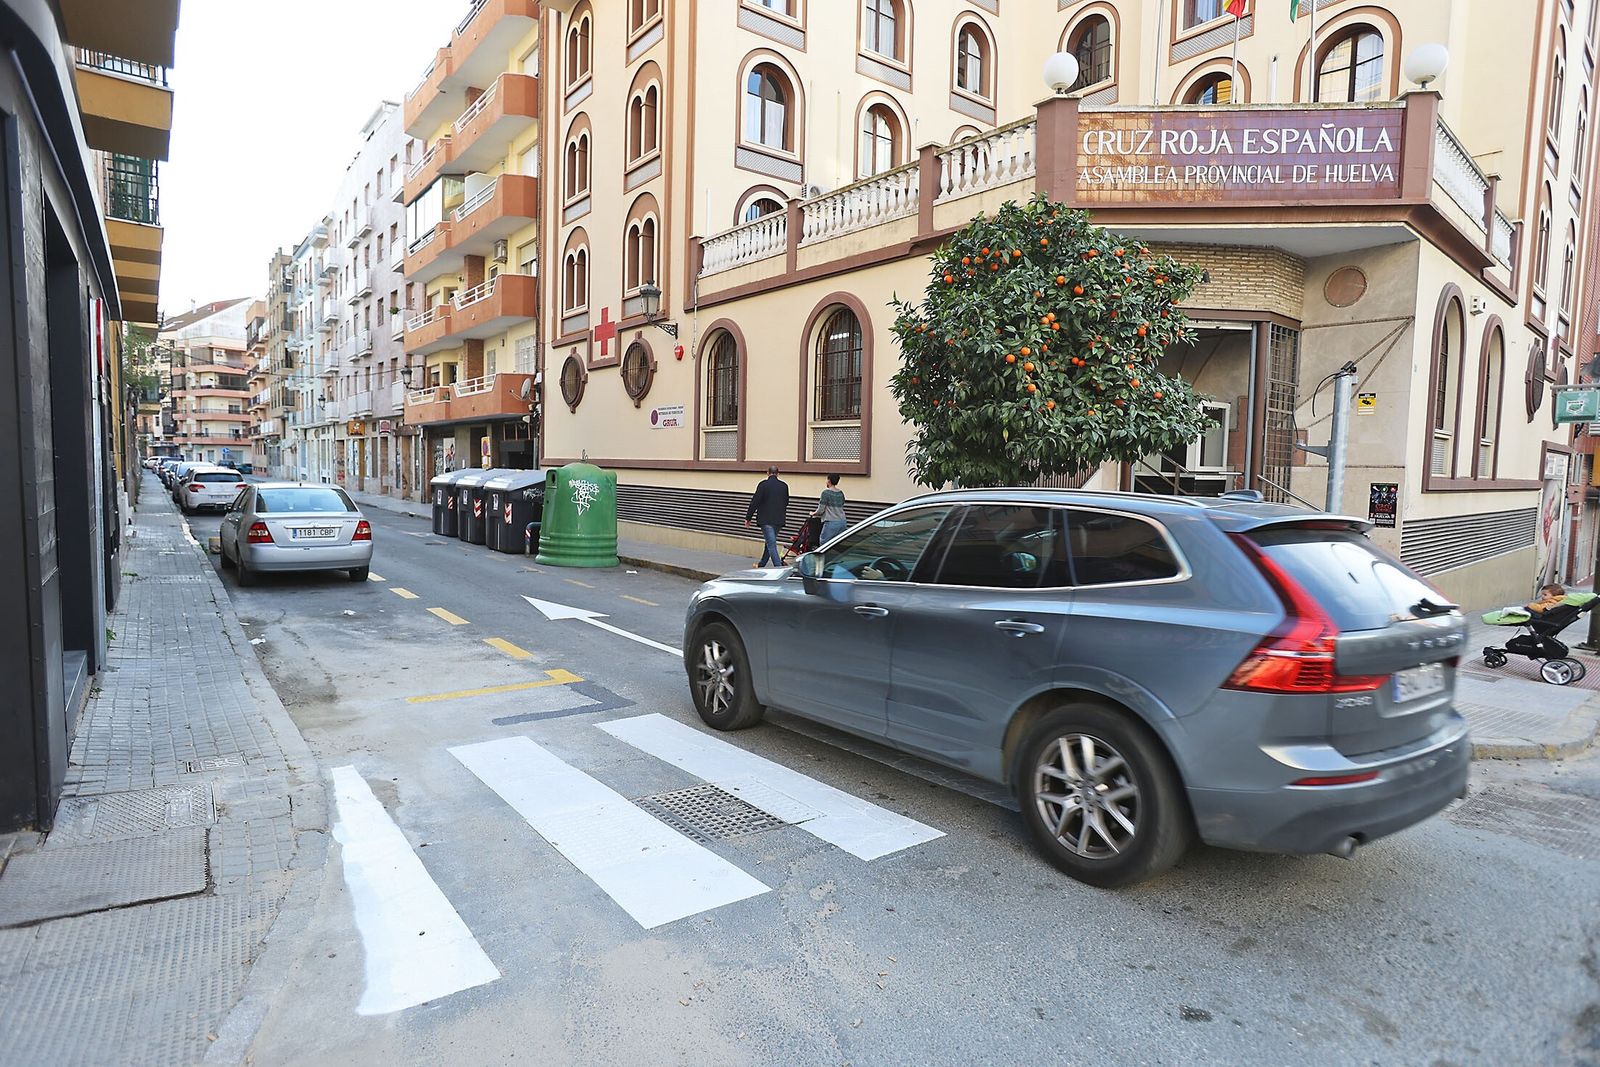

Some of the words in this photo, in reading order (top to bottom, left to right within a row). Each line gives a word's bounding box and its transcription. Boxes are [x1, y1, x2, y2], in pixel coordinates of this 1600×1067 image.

[1082, 129, 1153, 155] CRUZ
[1160, 129, 1233, 155] ROJA
[1242, 123, 1394, 154] ESPAÑOLA
[1078, 165, 1178, 184] ASAMBLEA
[1185, 165, 1285, 184] PROVINCIAL
[1292, 165, 1318, 183] DE
[1325, 164, 1394, 183] HUELVA
